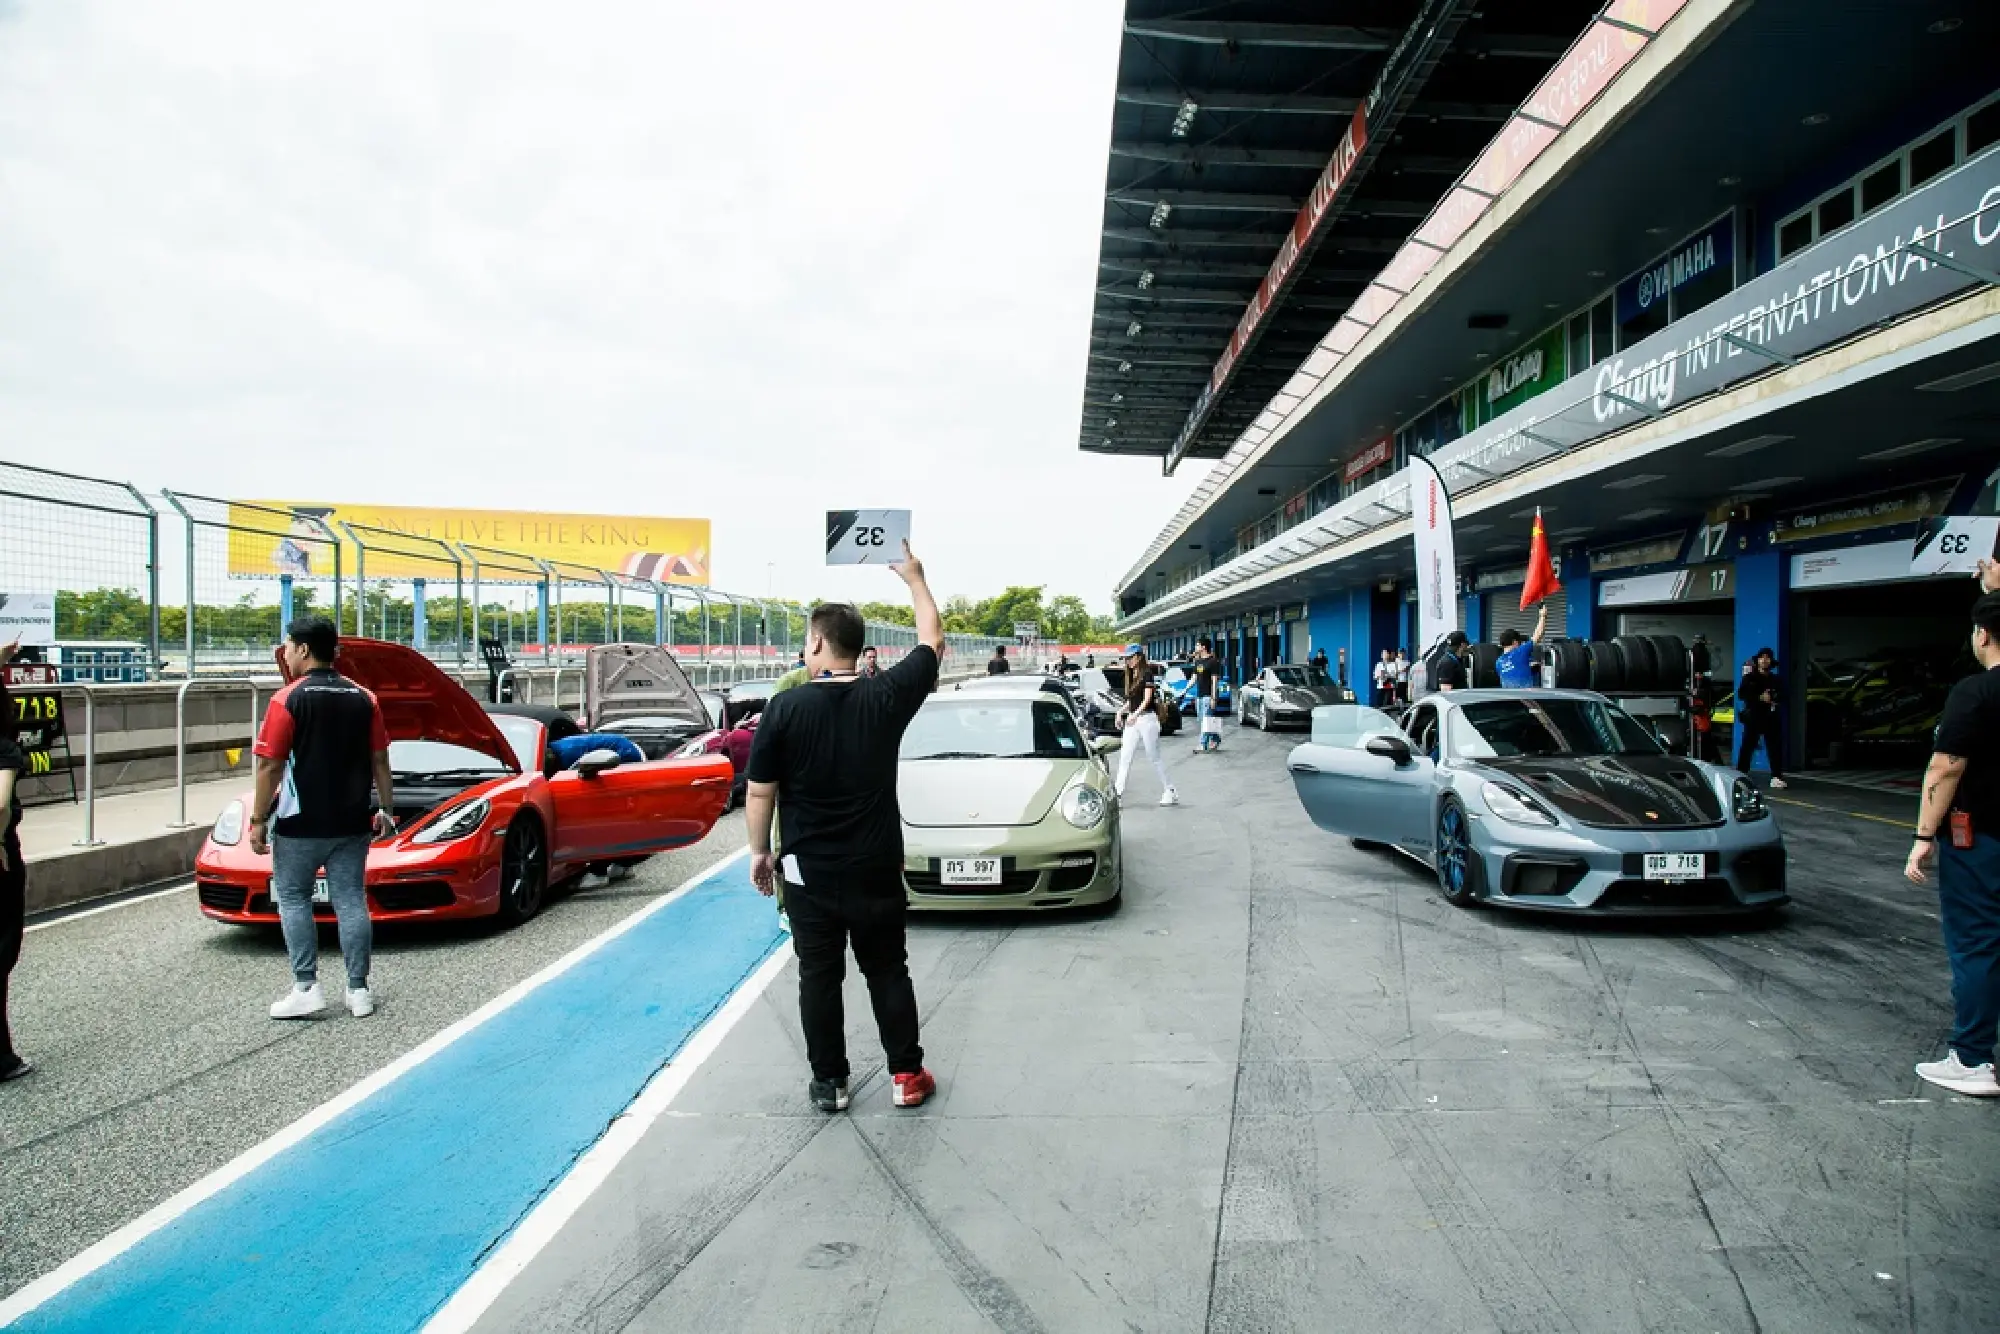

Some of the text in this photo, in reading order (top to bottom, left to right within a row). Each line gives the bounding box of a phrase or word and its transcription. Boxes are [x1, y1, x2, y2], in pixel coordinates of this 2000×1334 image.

[1653, 233, 1715, 298] YAMAHA
[1594, 347, 1678, 422] Chang
[1685, 213, 1955, 378] INTERNATIONAL
[1504, 348, 1544, 394] Chang
[349, 515, 650, 547] LONG LIVE THE KING
[854, 526, 886, 547] 32
[1700, 521, 1728, 558] 17
[1940, 533, 1970, 554] 33
[1711, 569, 1728, 591] 17
[13, 696, 58, 720] 718
[974, 860, 996, 874] 997
[1677, 855, 1699, 868] 718
